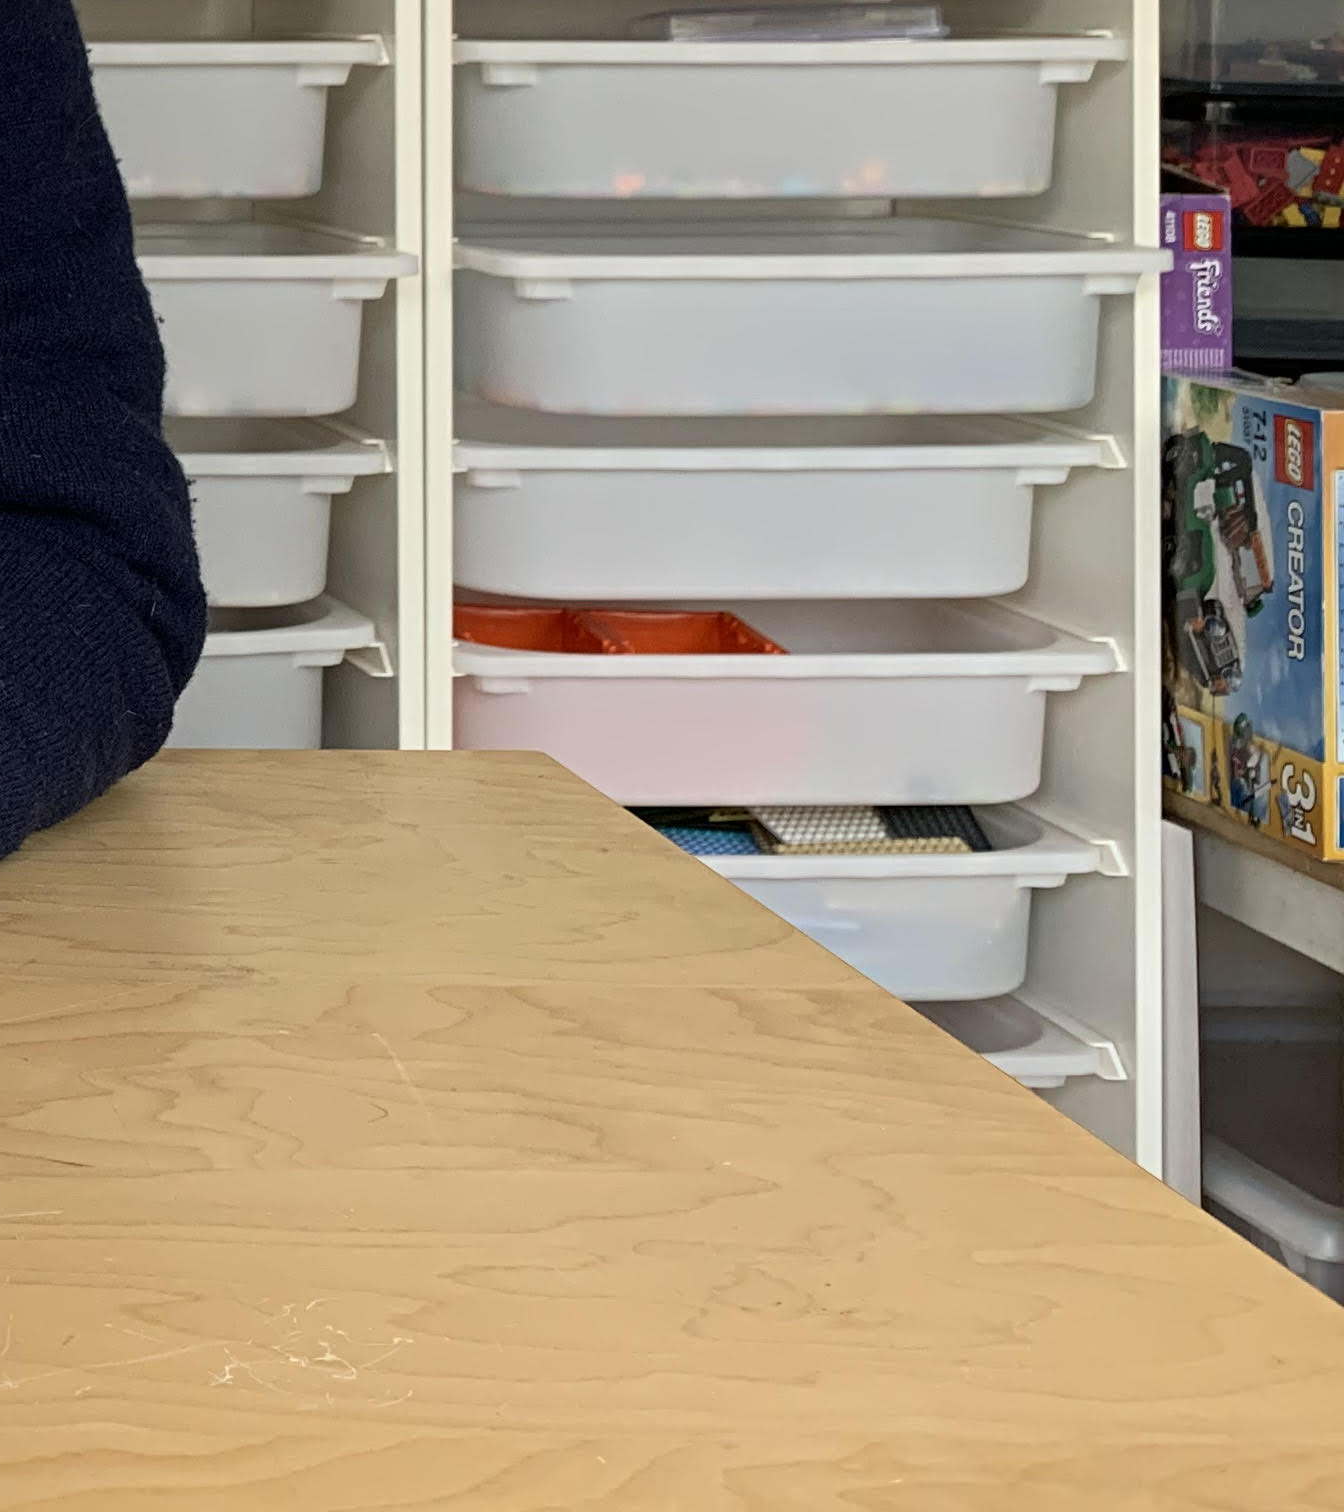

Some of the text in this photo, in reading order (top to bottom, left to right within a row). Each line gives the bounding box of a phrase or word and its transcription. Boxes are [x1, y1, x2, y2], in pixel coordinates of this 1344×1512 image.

[1193, 213, 1212, 249] LEGO
[1189, 259, 1220, 333] Friends
[1252, 411, 1267, 462] 7-12
[1287, 422, 1303, 483] LEGO
[1287, 501, 1305, 661] CREATOR
